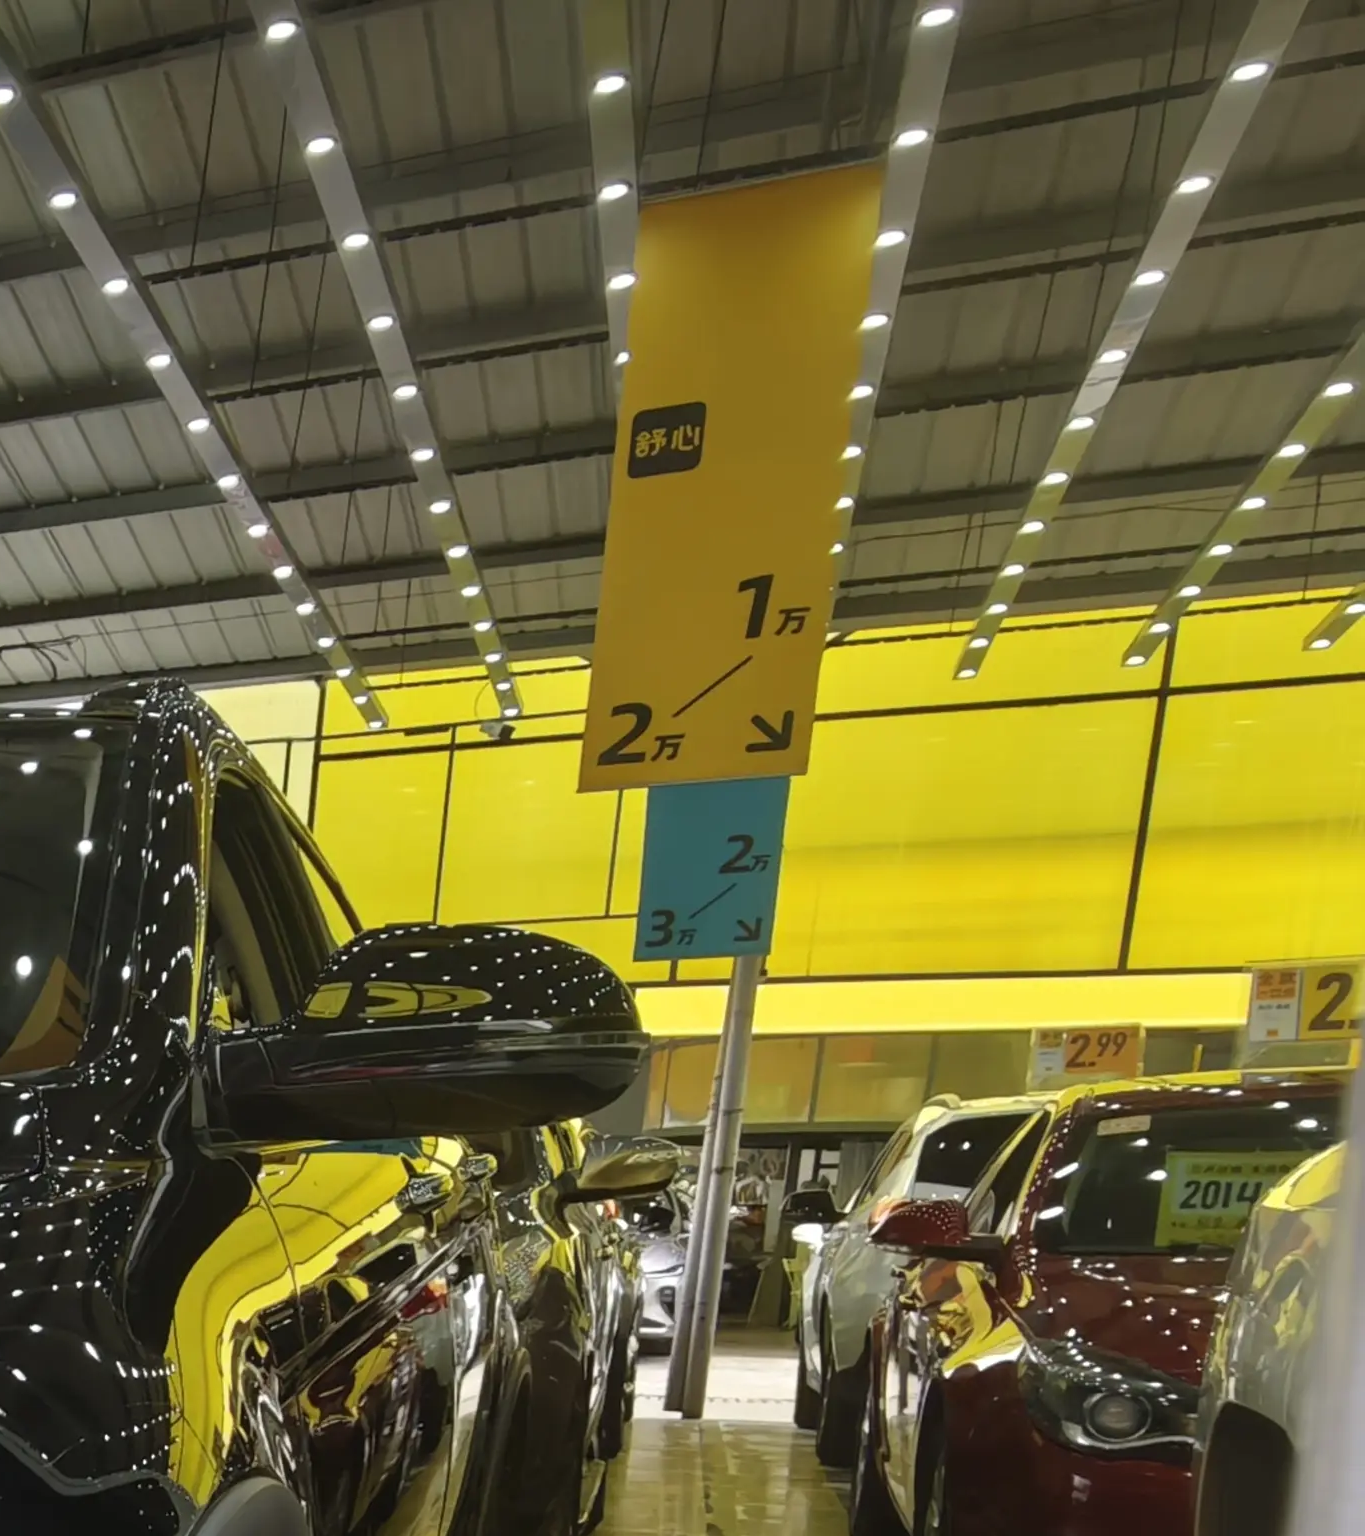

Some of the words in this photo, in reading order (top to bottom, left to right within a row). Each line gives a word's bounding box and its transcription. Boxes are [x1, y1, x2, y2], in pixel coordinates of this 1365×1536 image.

[635, 423, 700, 457] 舒心
[737, 574, 811, 639] 1万
[597, 702, 685, 766] 2万
[719, 835, 771, 875] 2万
[645, 910, 698, 948] 3万
[1065, 1032, 1127, 1068] 2.99
